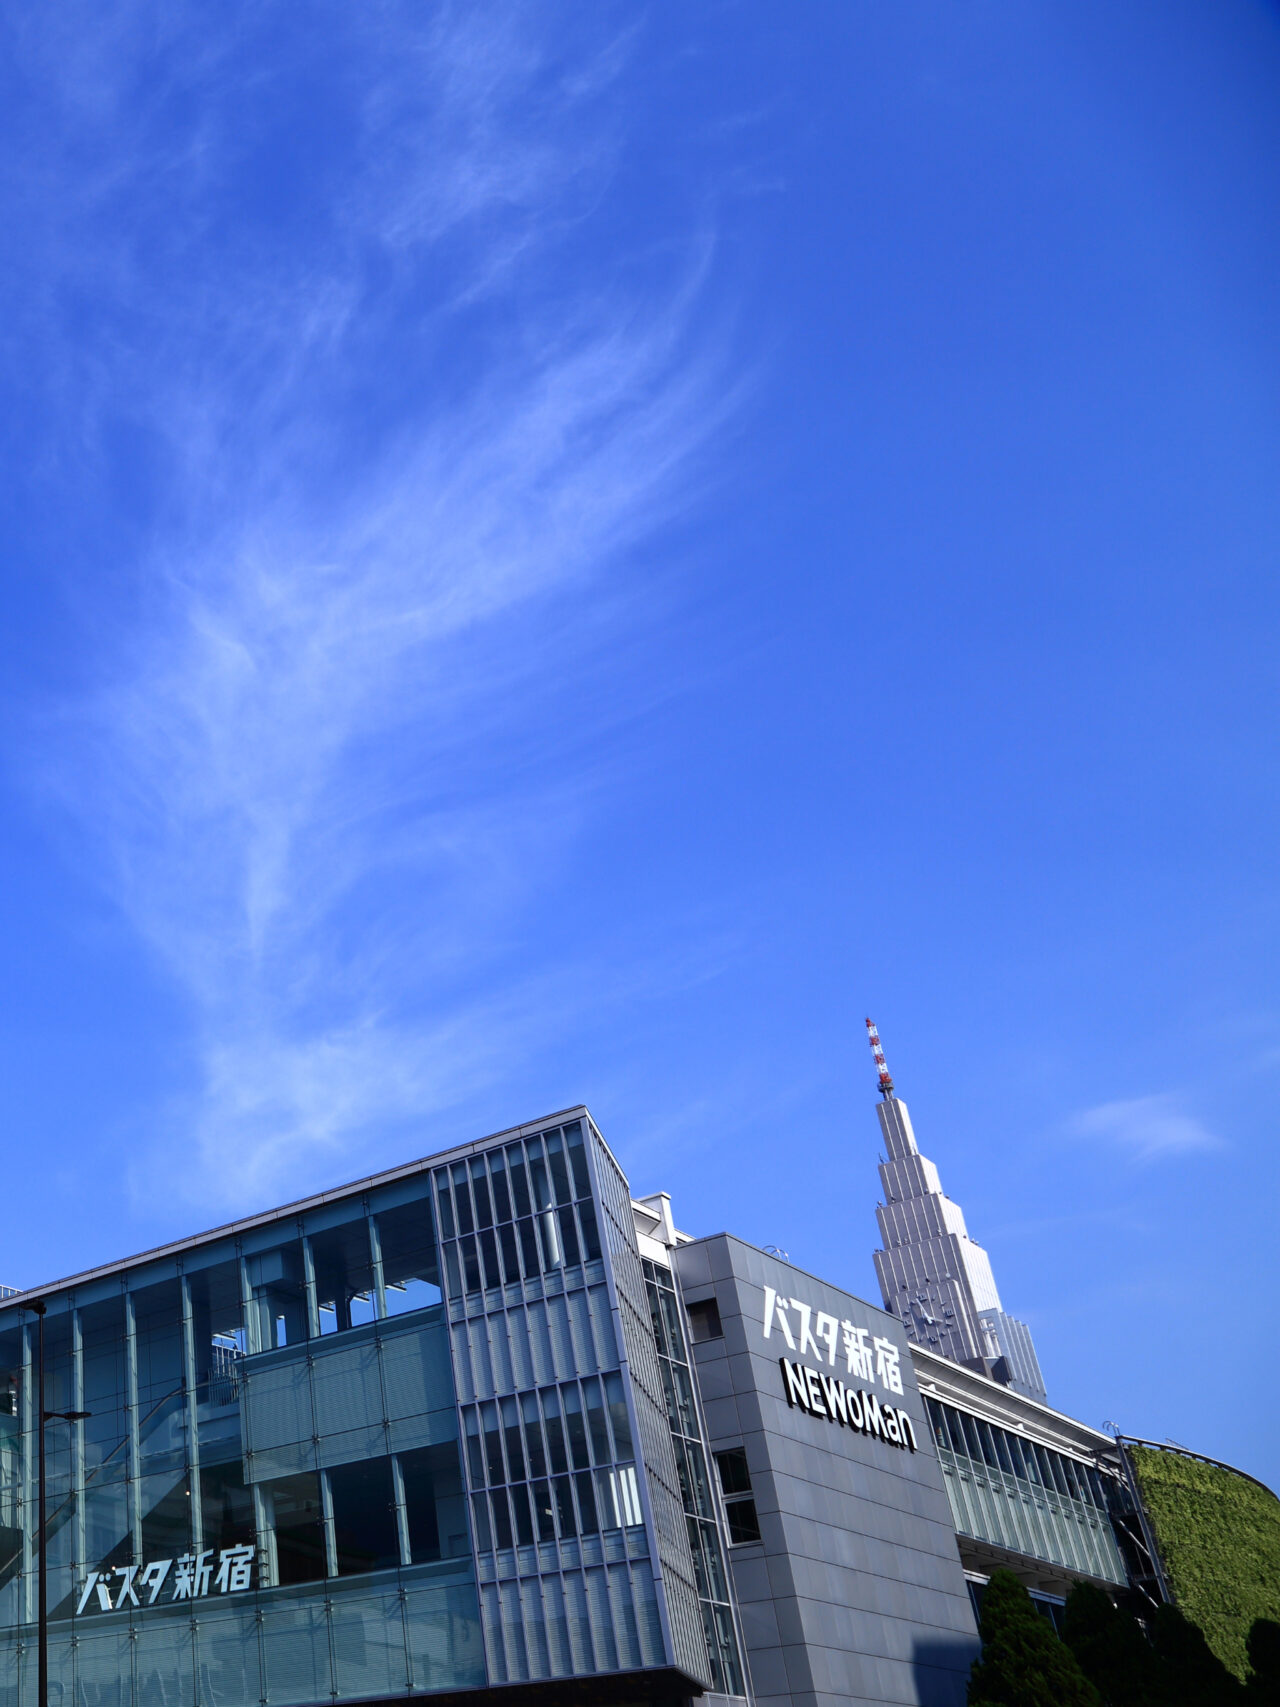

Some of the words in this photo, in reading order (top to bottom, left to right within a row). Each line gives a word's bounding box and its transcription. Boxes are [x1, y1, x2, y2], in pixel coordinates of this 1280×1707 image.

[763, 1285, 904, 1396] バスタ新宿
[781, 1357, 918, 1452] NEWoMan
[75, 1543, 256, 1615] バスタ新宿
